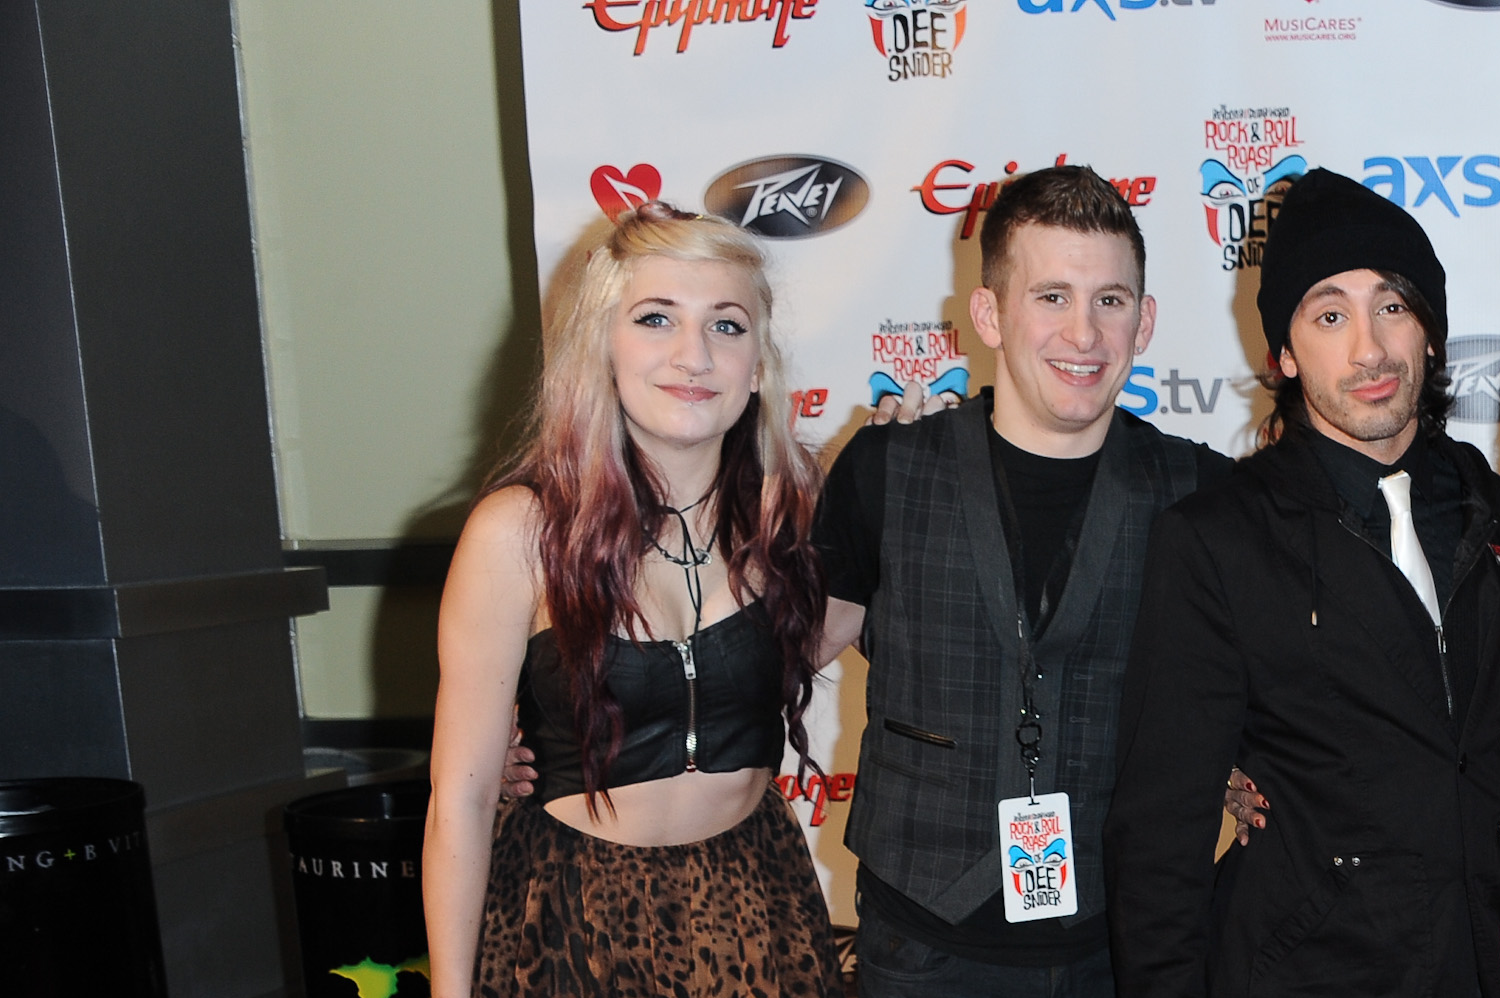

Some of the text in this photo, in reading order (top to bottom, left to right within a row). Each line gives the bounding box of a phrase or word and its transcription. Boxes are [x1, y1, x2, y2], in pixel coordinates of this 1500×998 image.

[893, 9, 946, 53] DEE
[1204, 116, 1305, 150] ROCK & ROLL
[1227, 145, 1279, 174] ROAST
[872, 329, 968, 363] ROCK & ROLL
[1009, 821, 1034, 840] ROCK
[1041, 816, 1064, 836] ROLL
[1025, 866, 1057, 893] DEE
